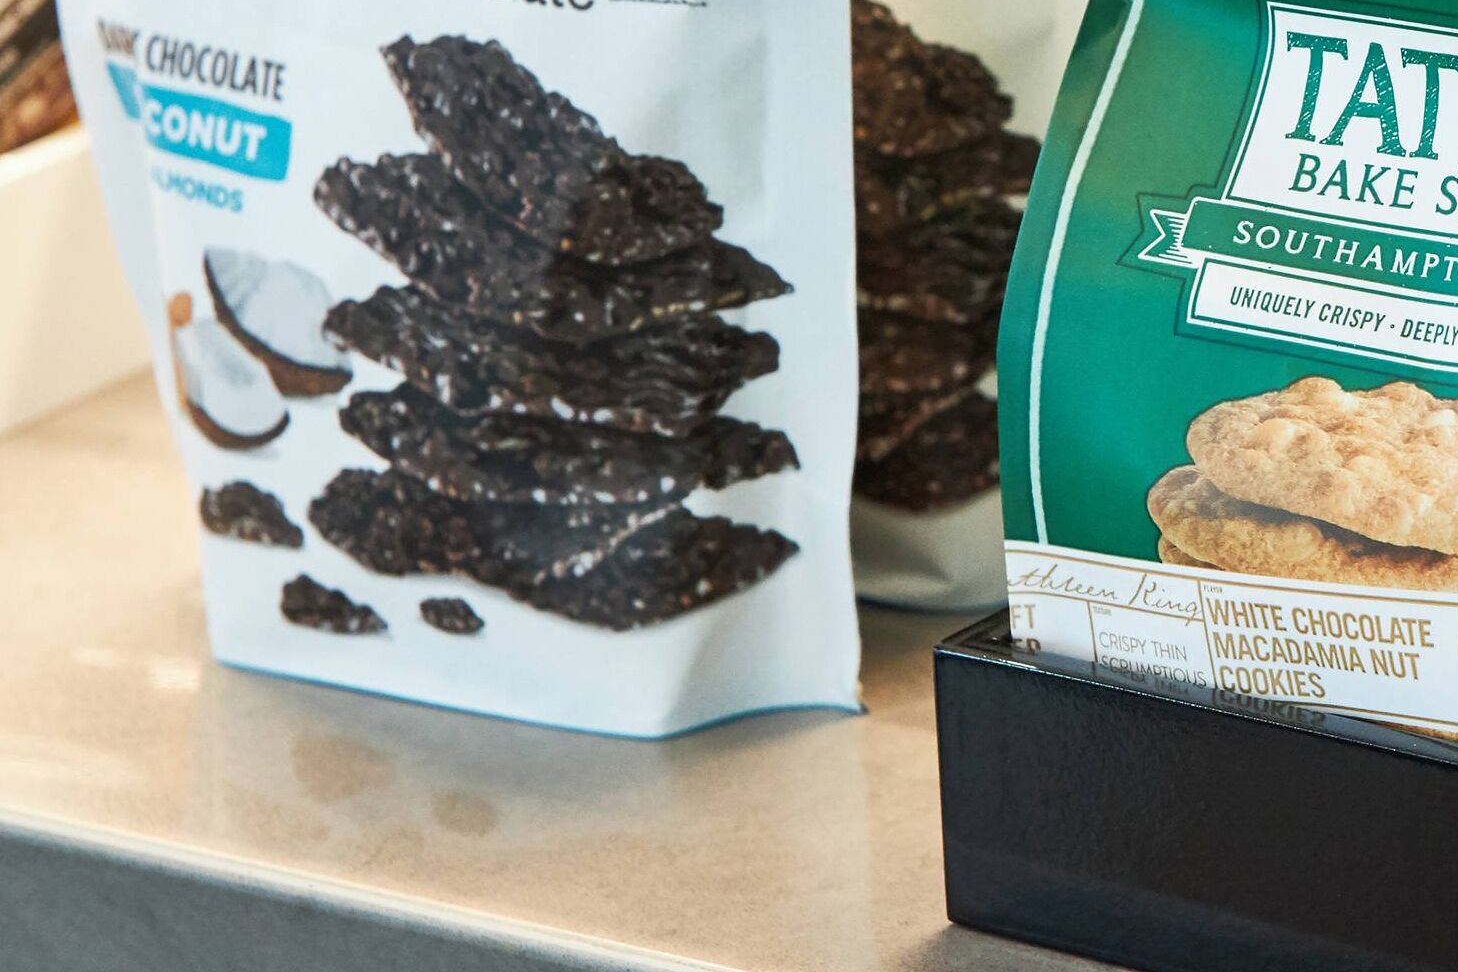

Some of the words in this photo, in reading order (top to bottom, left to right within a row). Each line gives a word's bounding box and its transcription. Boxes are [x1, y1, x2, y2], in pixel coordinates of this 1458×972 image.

[146, 33, 287, 103] CHOCOLATE
[1288, 153, 1418, 209] BAKE
[1229, 285, 1317, 319] UNIQUELY
[1318, 303, 1387, 333] CRISPY
[1099, 631, 1146, 655] CRISPY
[1151, 640, 1188, 662] THIN
[1206, 597, 1288, 633] WHITE
[1291, 607, 1435, 649] CHOCOLATE
[1212, 631, 1367, 674] MACADAMIA
[1369, 648, 1421, 681] NUT
[1219, 665, 1326, 699] COOKIES
